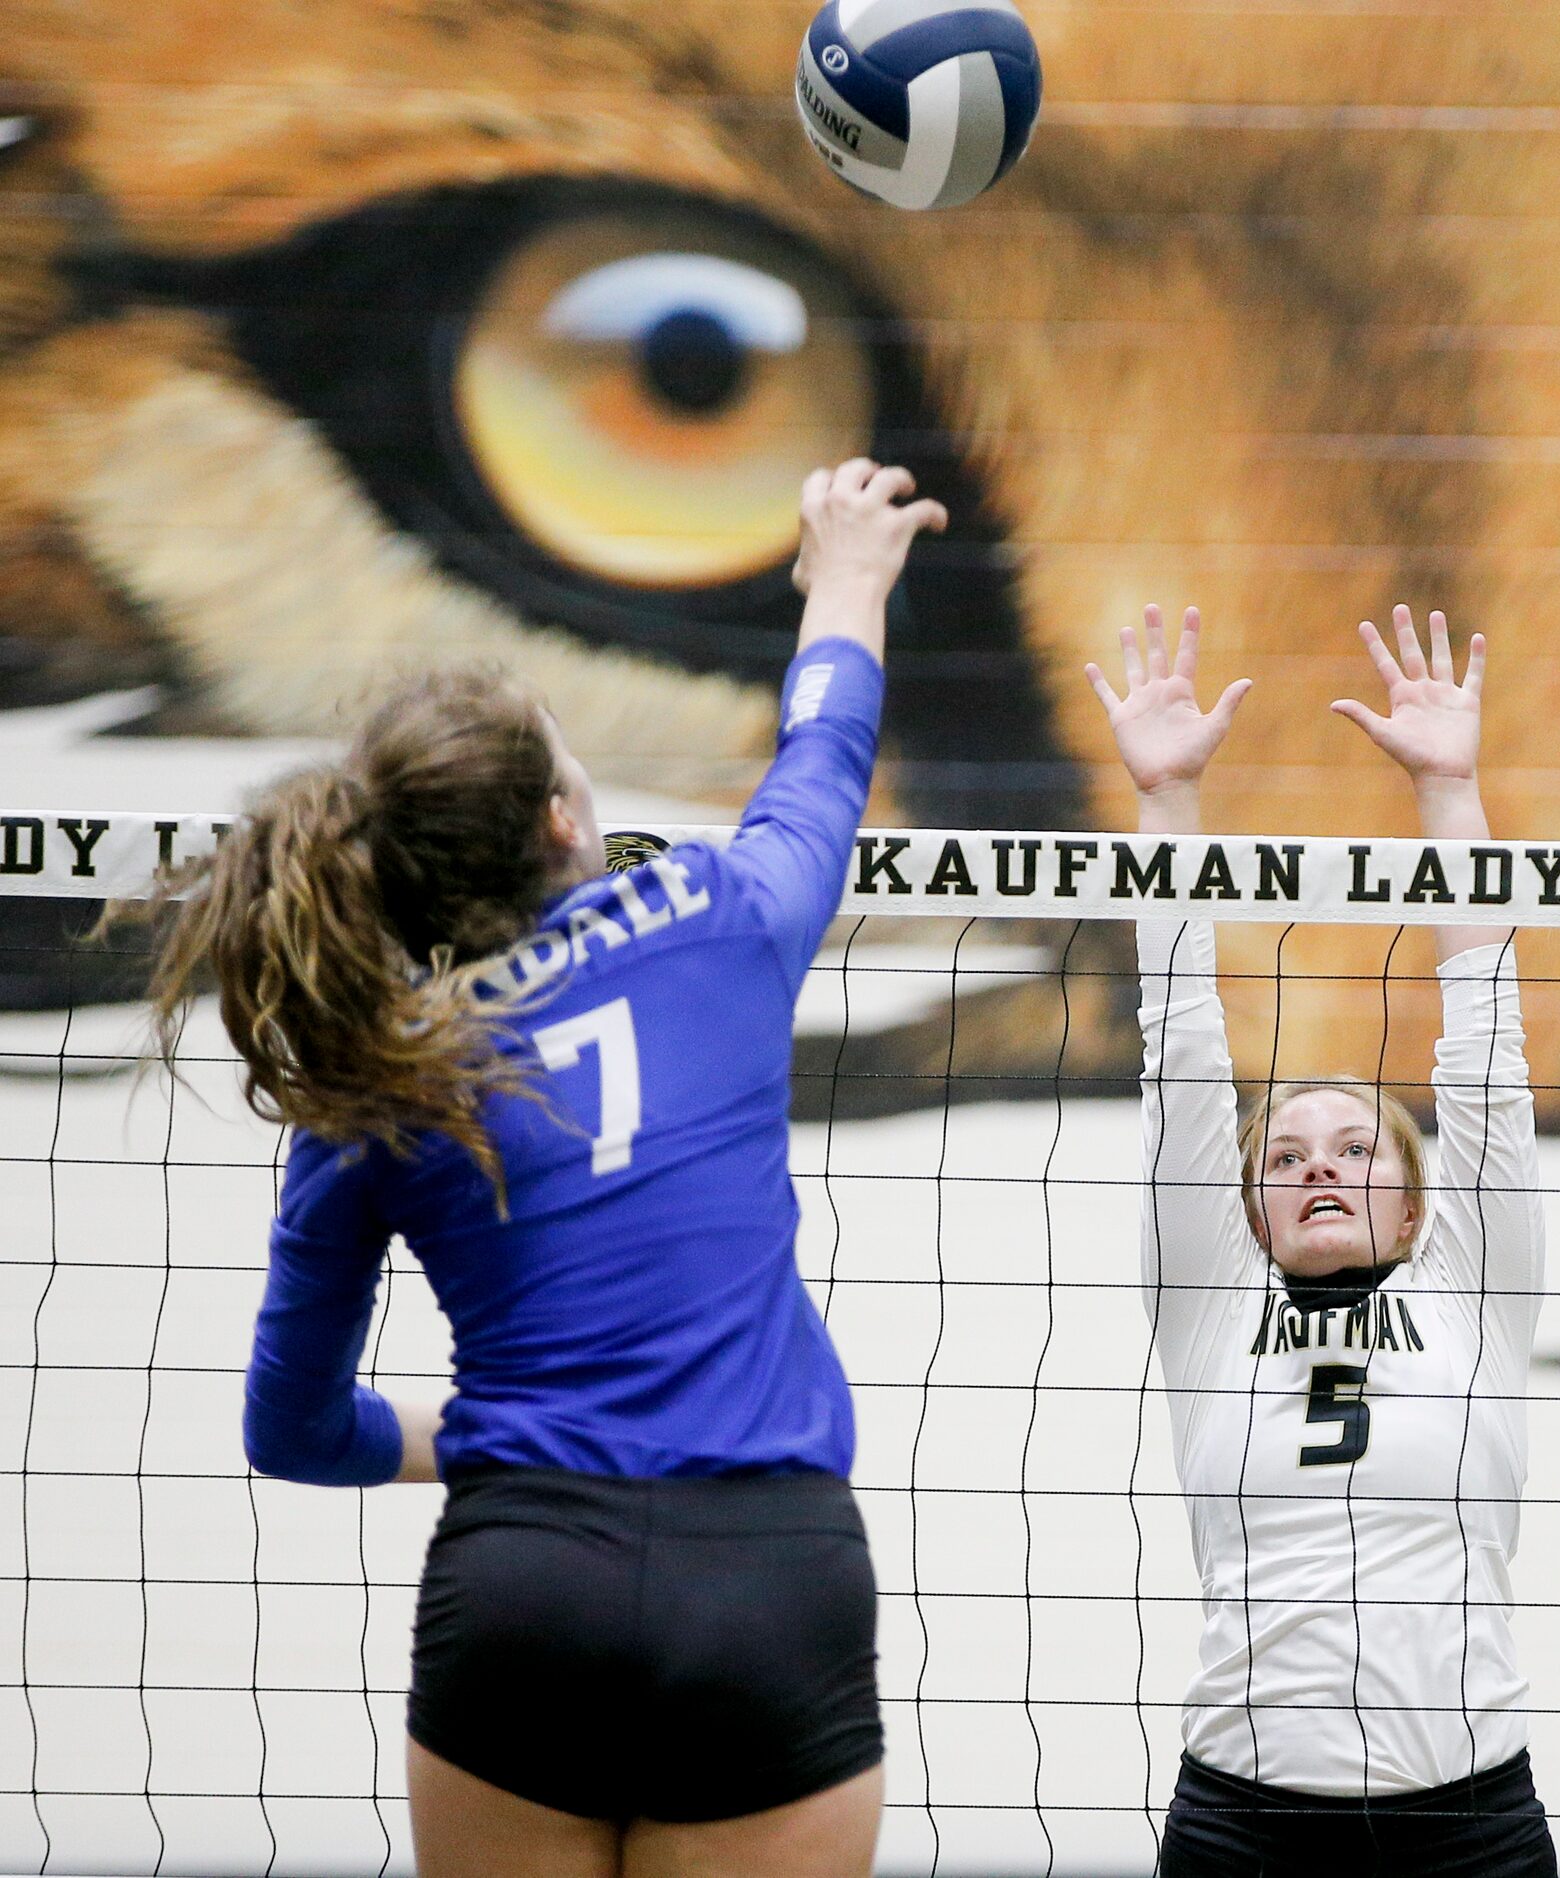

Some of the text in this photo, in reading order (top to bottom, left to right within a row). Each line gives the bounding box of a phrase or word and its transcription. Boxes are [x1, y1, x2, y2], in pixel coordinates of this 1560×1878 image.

[853, 836, 1306, 901] KAUFMAN
[532, 996, 642, 1177] 7
[1250, 1291, 1425, 1355] KAUFMAN
[1297, 1362, 1374, 1470] 5
